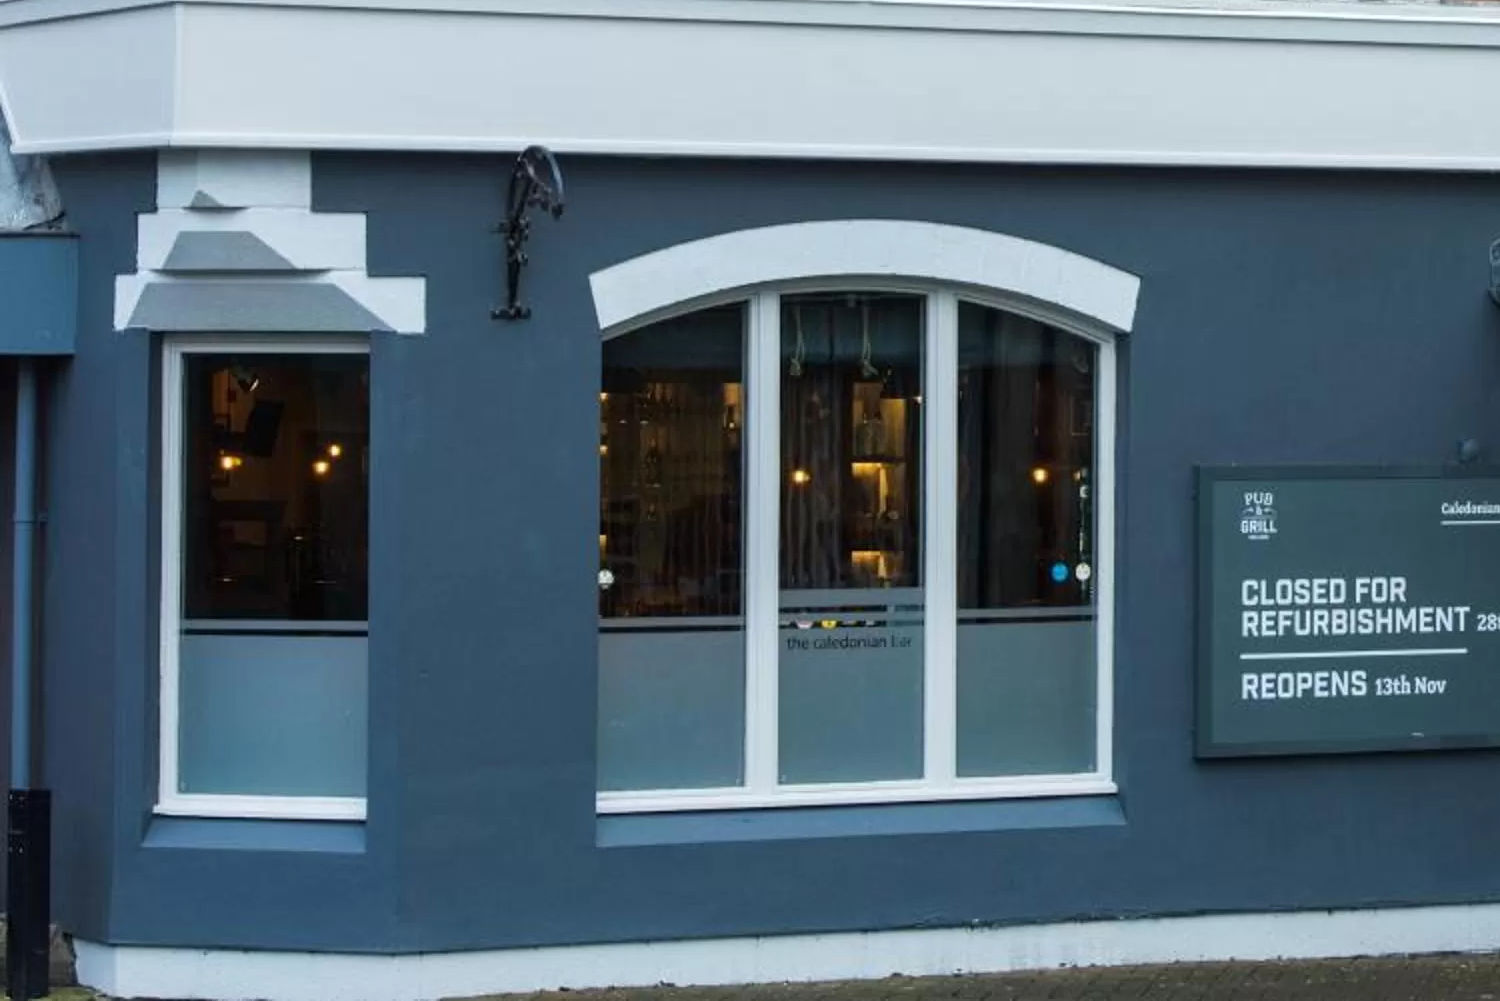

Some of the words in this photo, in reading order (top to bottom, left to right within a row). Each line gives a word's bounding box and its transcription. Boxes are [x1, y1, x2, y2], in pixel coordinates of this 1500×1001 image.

[1244, 492, 1273, 506] PUB
[1441, 501, 1500, 515] Caledonian
[1240, 520, 1278, 534] GRILL
[1241, 577, 1347, 606] CLOSED
[1355, 576, 1407, 604] FOR
[1241, 606, 1470, 637] REFURBISHMENT
[786, 636, 810, 651] the
[813, 634, 887, 650] caledonian
[1241, 670, 1367, 700] REOPENS
[1375, 677, 1411, 697] 13th
[1415, 676, 1447, 695] Nov
